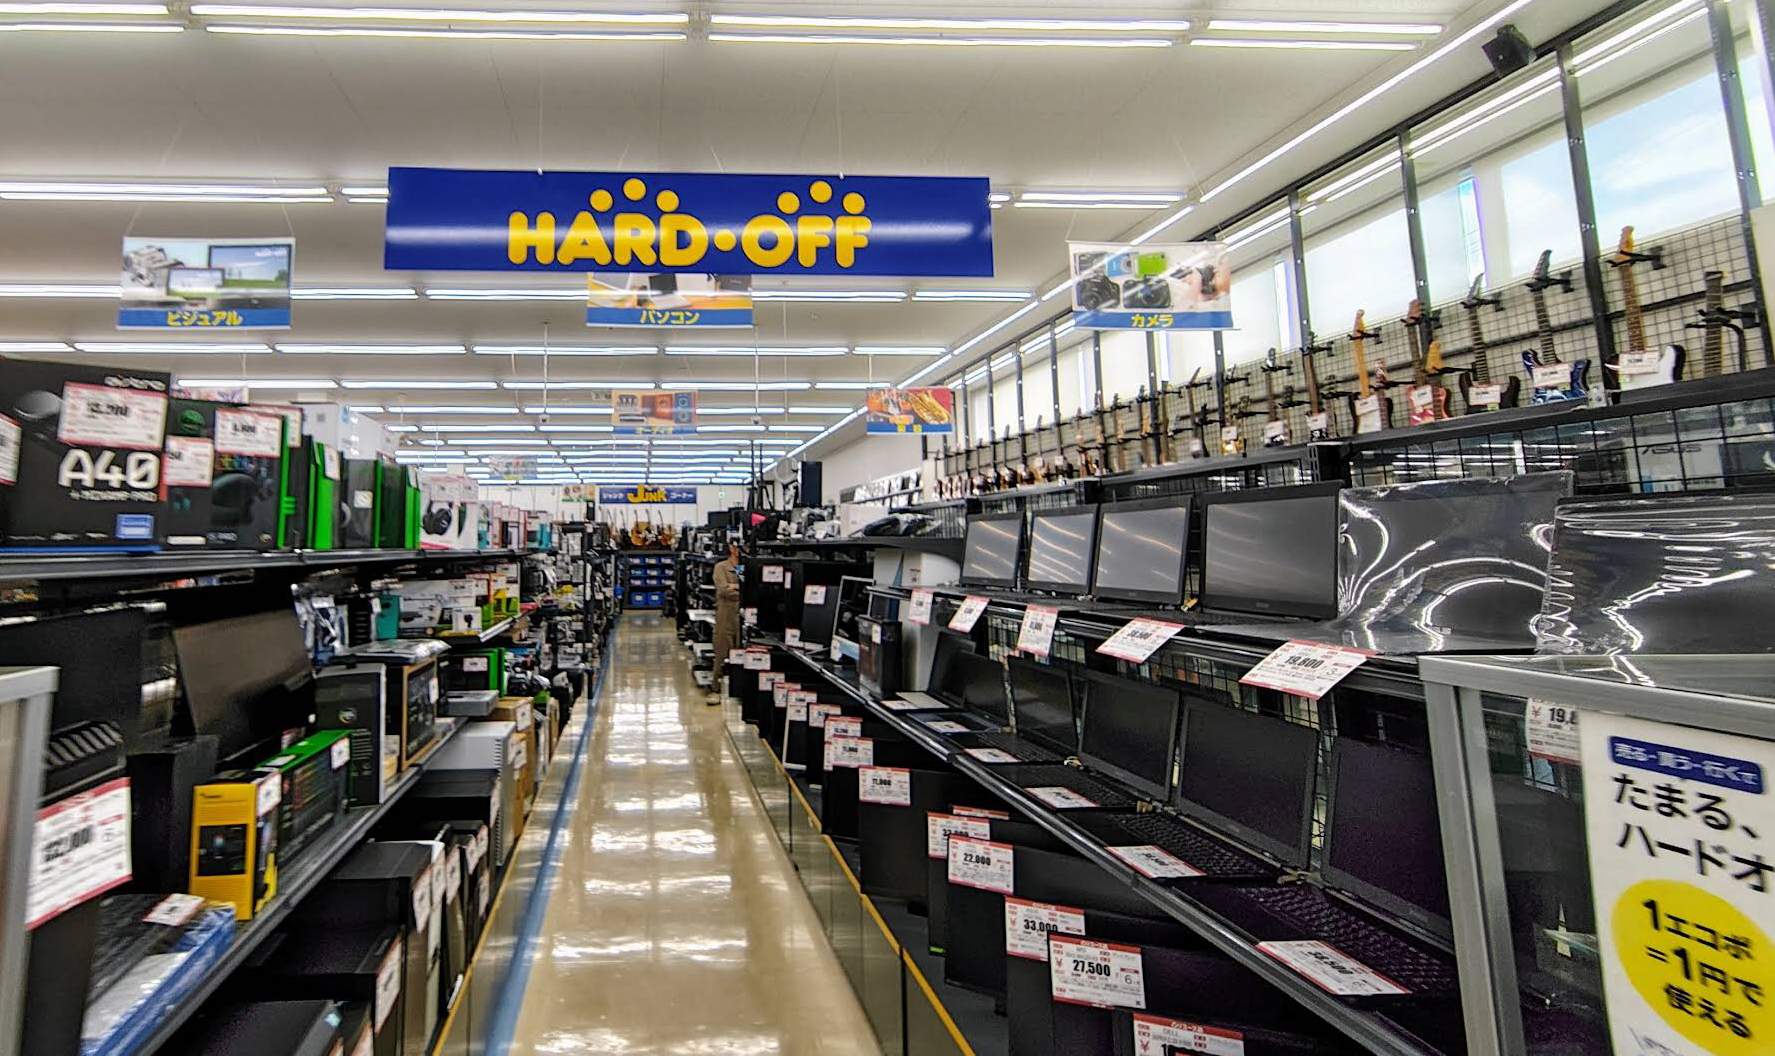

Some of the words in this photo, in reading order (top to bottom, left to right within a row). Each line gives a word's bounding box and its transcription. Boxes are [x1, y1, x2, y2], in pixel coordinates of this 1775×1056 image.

[167, 310, 243, 326] ビジュアル
[640, 309, 700, 325] パソコン
[1131, 313, 1174, 328] カメラ
[58, 448, 160, 490] A40
[1612, 773, 1759, 839] たまる、
[1643, 899, 1754, 960] 1エコポ
[1072, 959, 1111, 976] 27,500
[1646, 947, 1765, 1007] =1円で
[1663, 983, 1752, 1039] 使える
